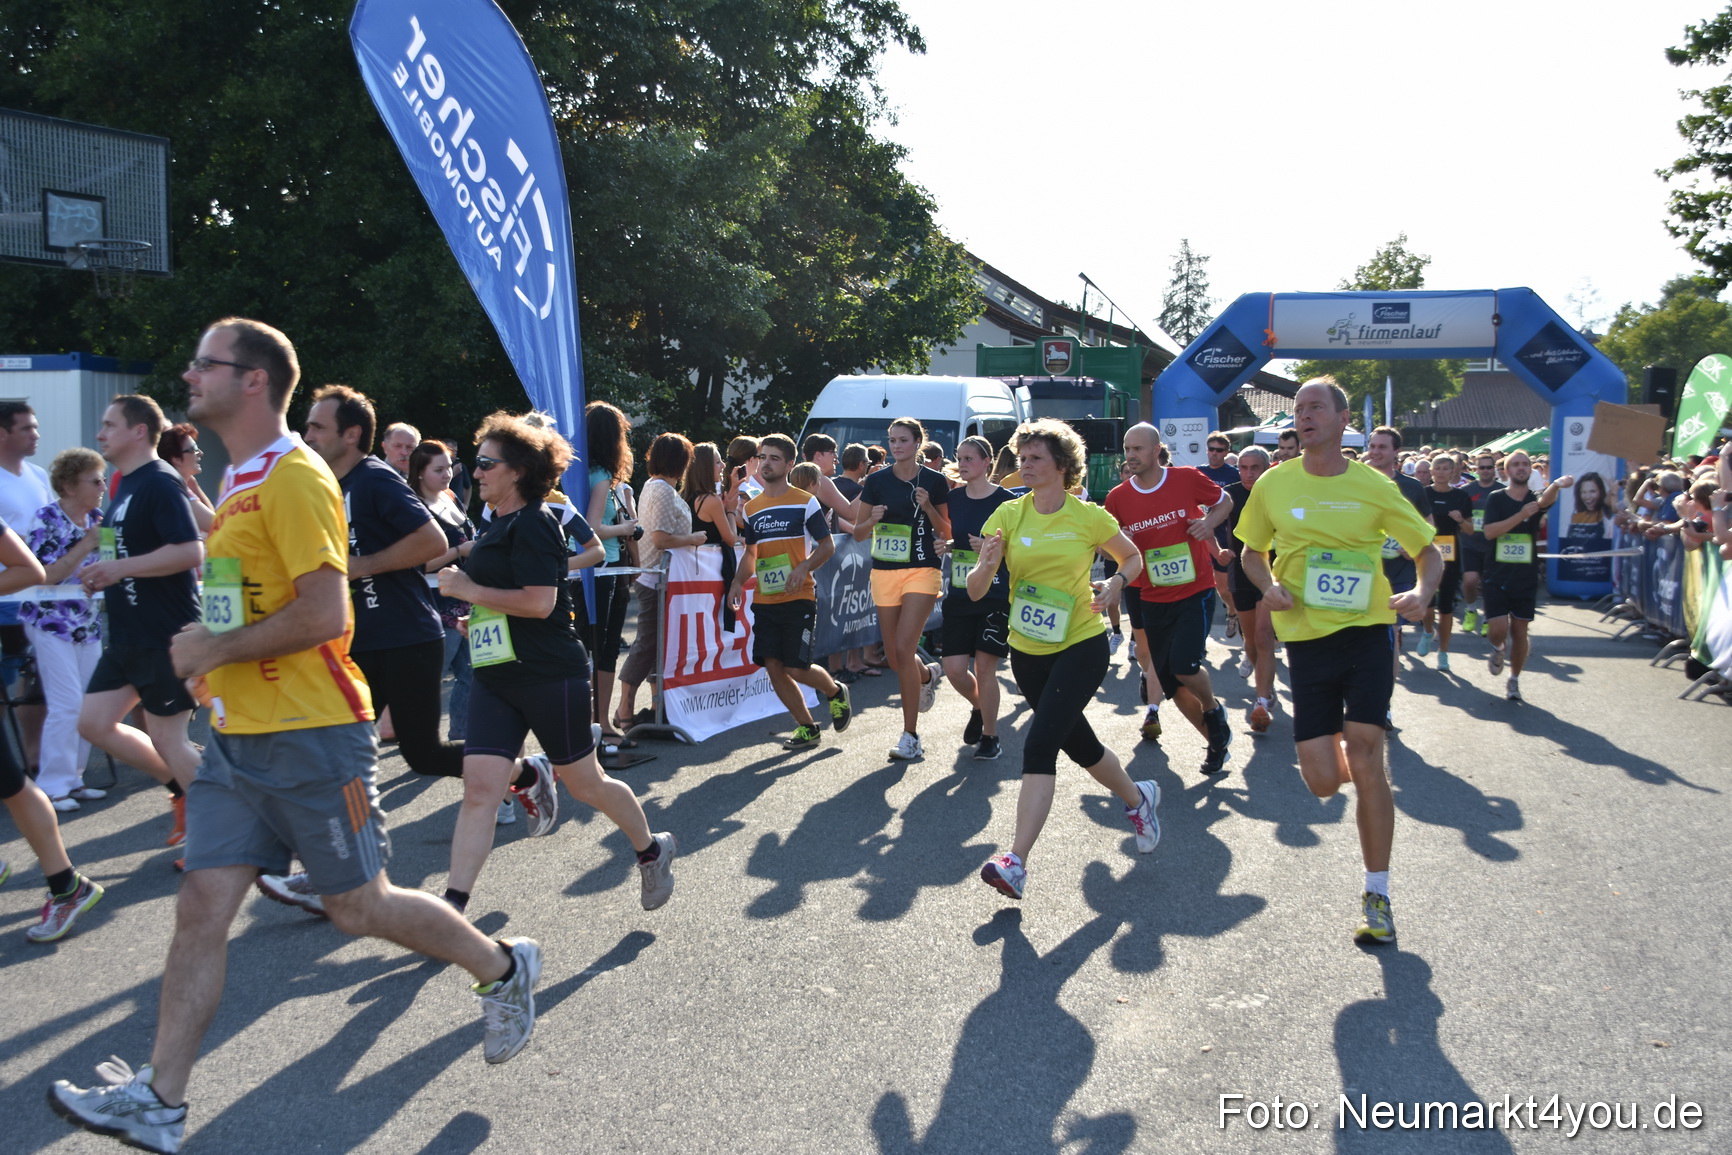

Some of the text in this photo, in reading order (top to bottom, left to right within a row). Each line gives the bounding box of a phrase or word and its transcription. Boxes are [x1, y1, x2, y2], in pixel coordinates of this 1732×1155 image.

[1379, 309, 1408, 317] Fischer
[1358, 324, 1442, 340] firmenlauf
[1203, 353, 1247, 364] Fischer
[758, 516, 790, 531] Fischer
[1128, 511, 1177, 532] NEUMARKT
[875, 537, 908, 553] 1133
[915, 539, 926, 561] RAIL
[1503, 544, 1525, 556] 328
[763, 569, 786, 585] 421
[1152, 559, 1188, 577] 1397
[361, 575, 379, 609] RAI
[1317, 573, 1360, 596] 637
[838, 582, 876, 616] Fisch
[1020, 604, 1057, 631] 654
[470, 624, 503, 650] 1241
[328, 816, 351, 860] adidas
